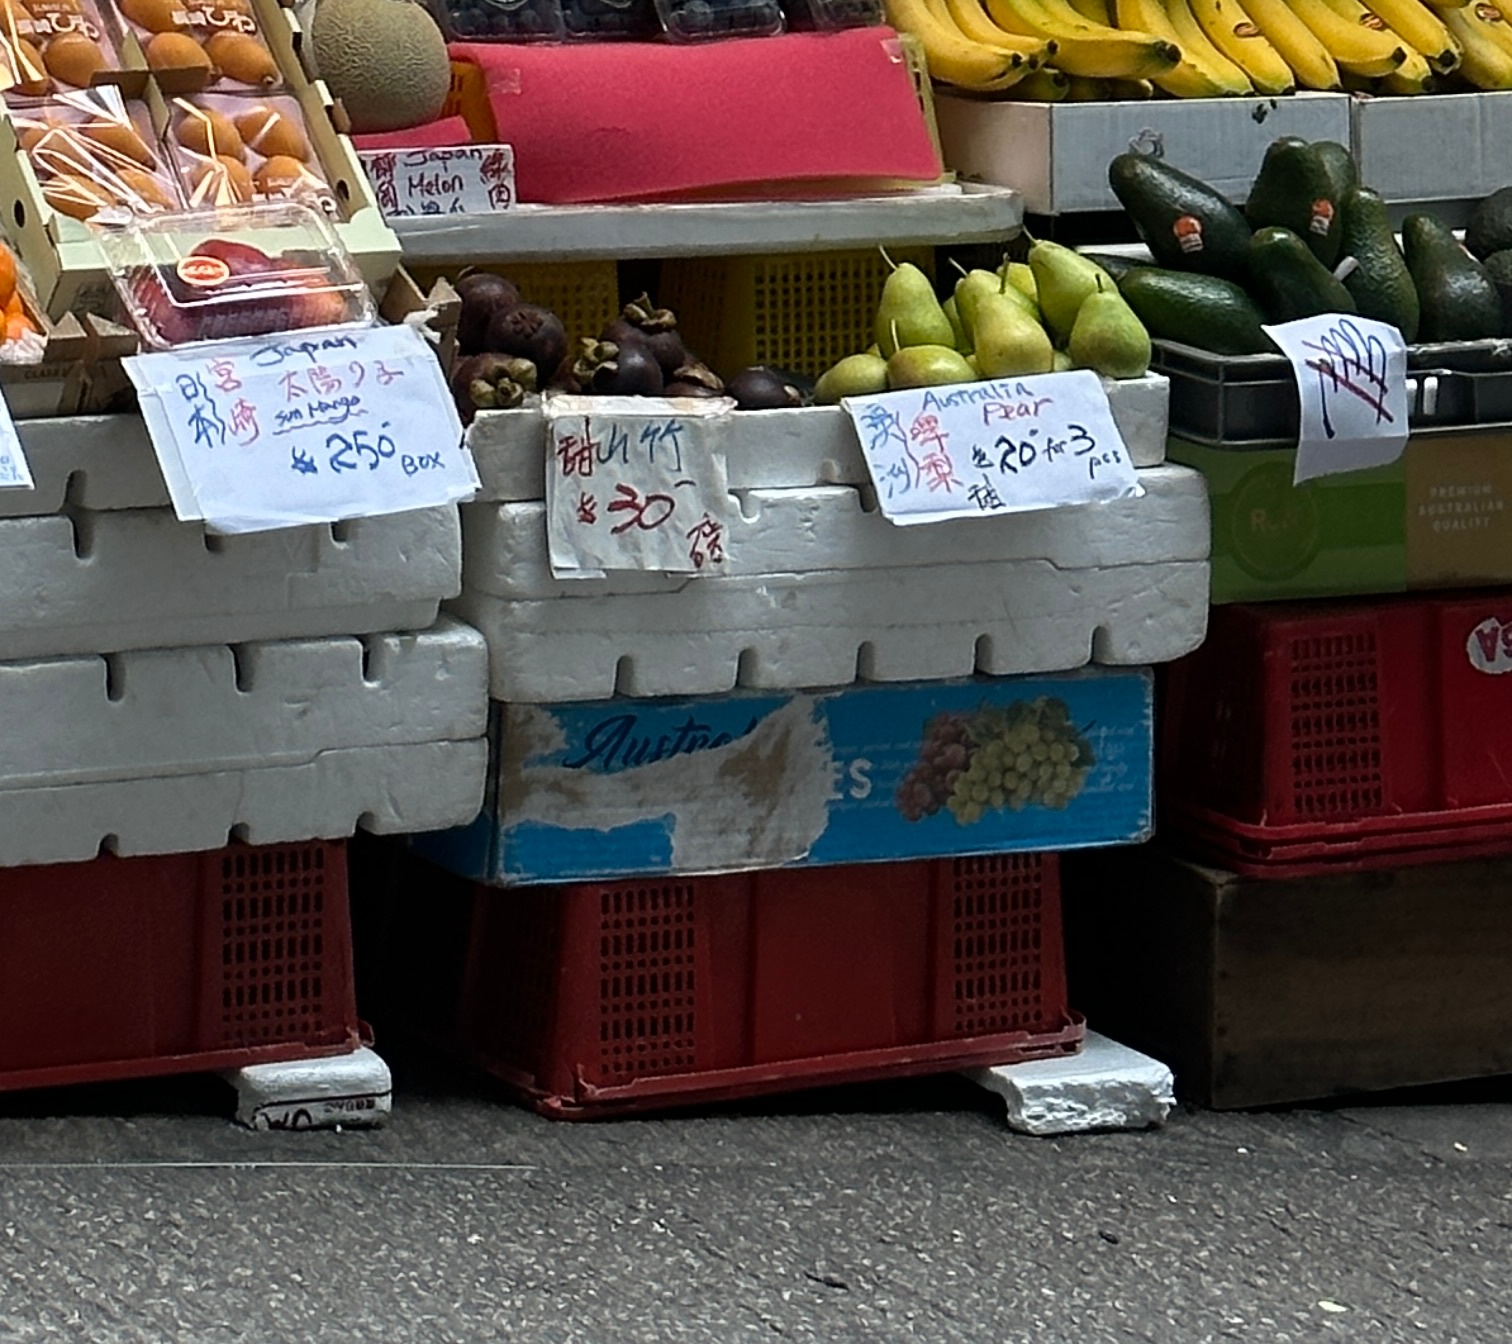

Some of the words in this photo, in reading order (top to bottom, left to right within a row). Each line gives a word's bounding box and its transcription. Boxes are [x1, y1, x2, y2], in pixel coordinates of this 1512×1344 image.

[403, 148, 484, 173] Japan
[408, 172, 464, 198] Melon
[249, 334, 359, 367] Japan
[1067, 424, 1096, 457] 3
[1430, 483, 1494, 499] PREMIUM
[1417, 498, 1505, 517] AUSTRALIAN
[1431, 516, 1490, 532] QUALITY
